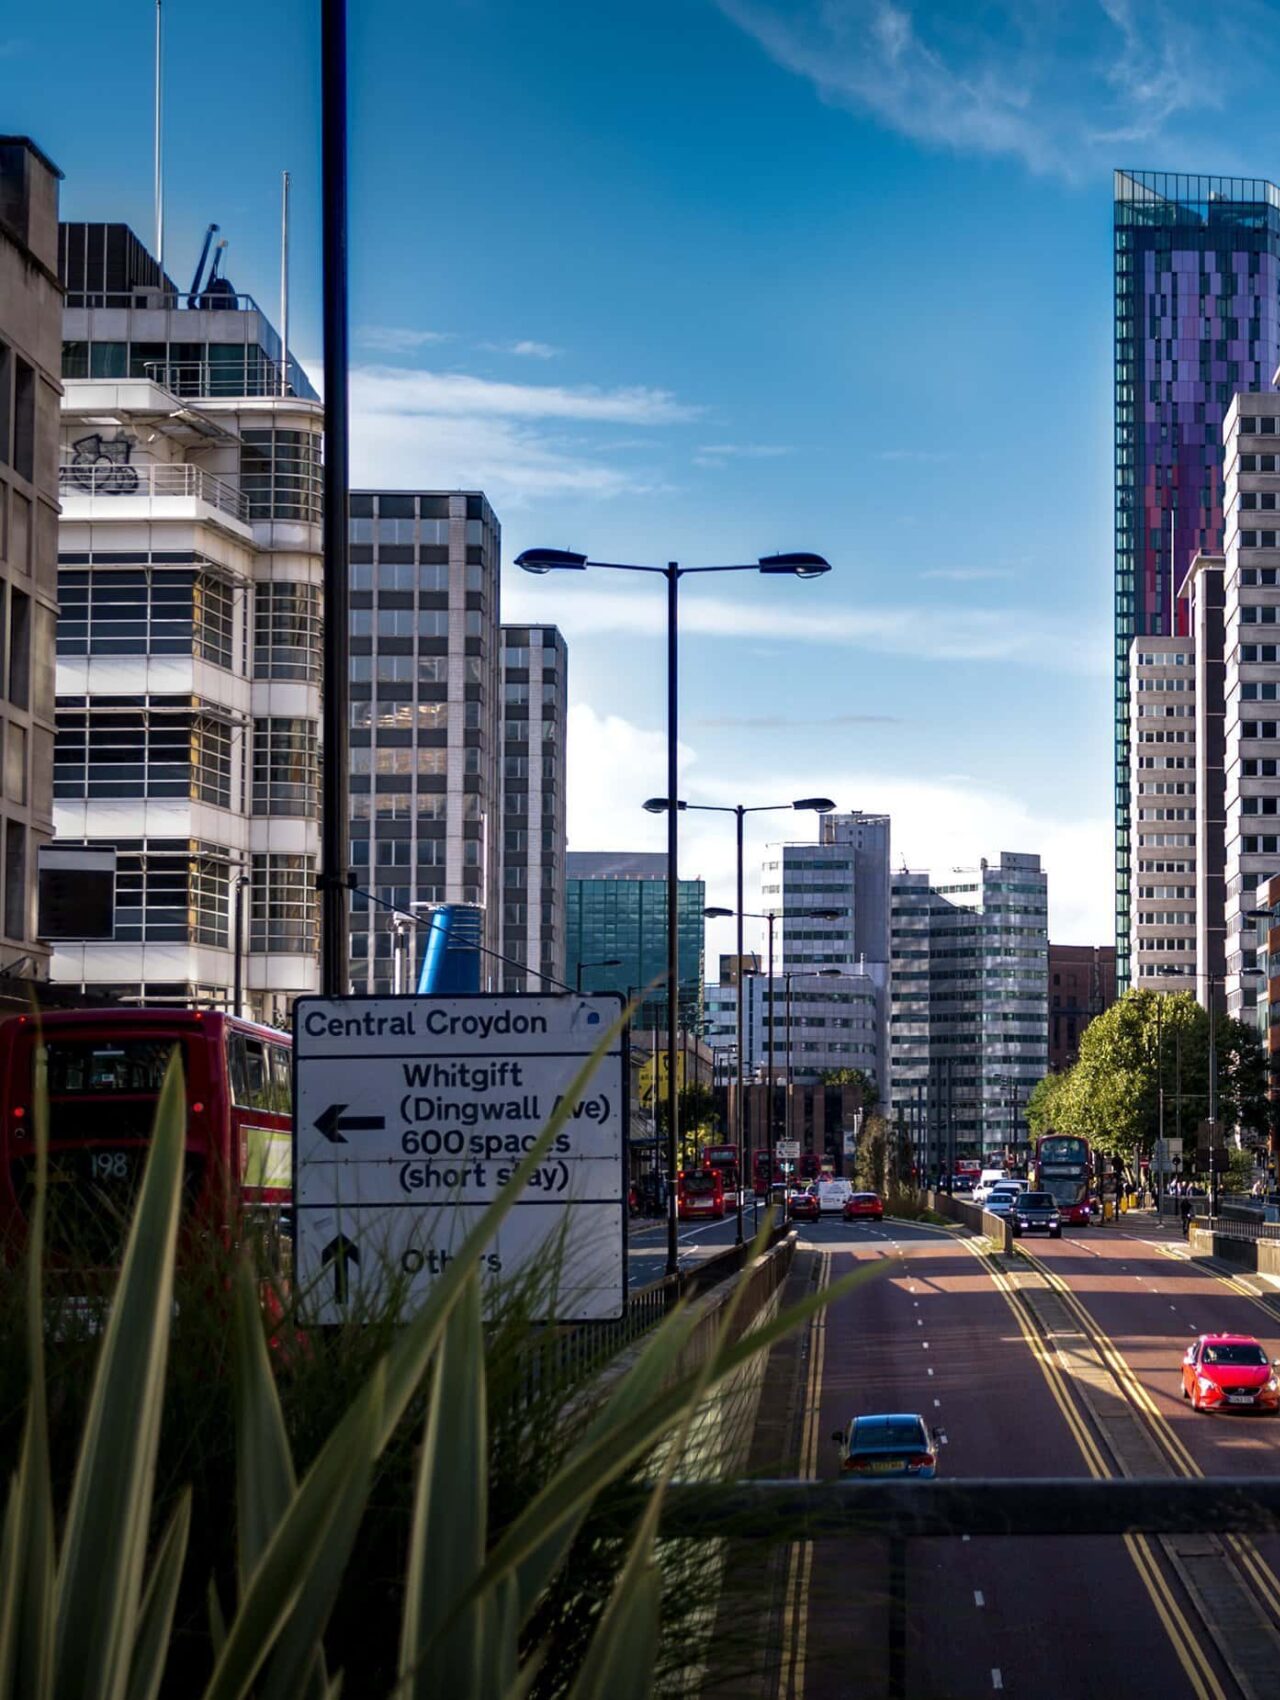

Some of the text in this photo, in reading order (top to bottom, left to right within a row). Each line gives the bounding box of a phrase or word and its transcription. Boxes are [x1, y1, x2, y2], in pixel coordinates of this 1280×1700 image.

[305, 1009, 547, 1039] Central Croydon
[403, 1062, 522, 1091] Whitgift
[400, 1096, 540, 1126] (Dingwall
[402, 1130, 570, 1159] 600 spacs
[92, 1153, 128, 1178] 198
[400, 1160, 569, 1192] (short say)
[402, 1249, 502, 1274] Oths
